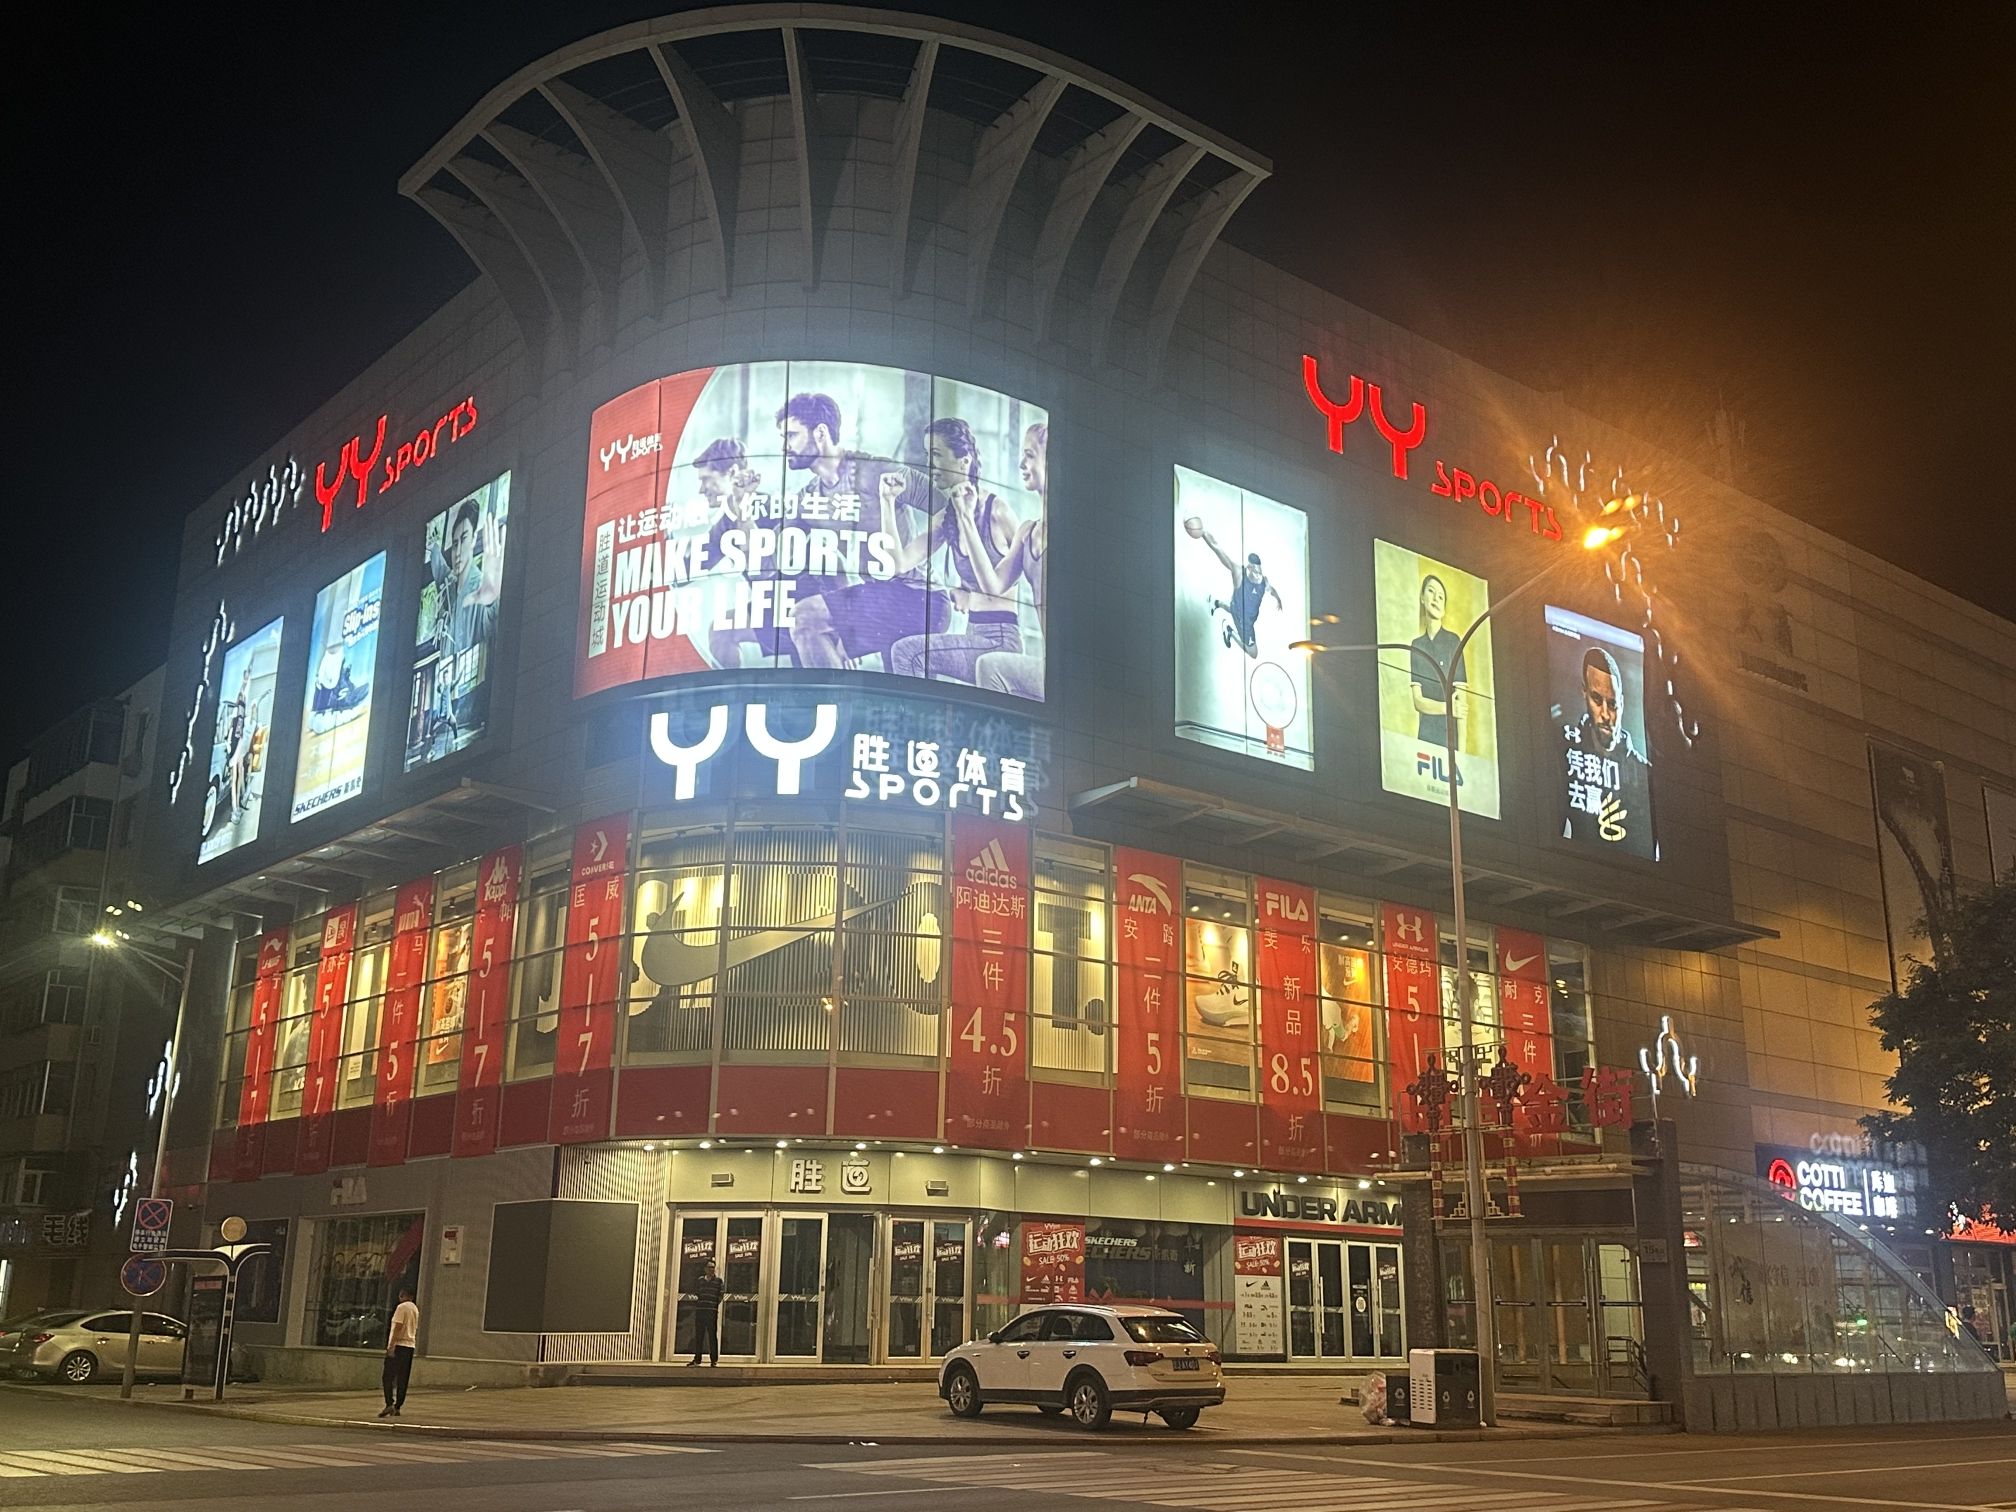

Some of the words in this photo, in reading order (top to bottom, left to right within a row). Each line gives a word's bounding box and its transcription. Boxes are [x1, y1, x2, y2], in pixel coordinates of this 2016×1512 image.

[600, 434, 633, 472] YY
[1303, 354, 1427, 480] YY
[1430, 460, 1562, 541] SPORTS
[315, 414, 388, 533] YY
[379, 396, 478, 494] SPORTS
[614, 532, 710, 599] MAKE
[720, 526, 897, 582] SPORTS
[611, 586, 704, 648] YOUR
[712, 580, 797, 632] LIFE
[650, 703, 838, 801] YY
[852, 733, 1027, 797] 胜道体育
[1566, 748, 1621, 791] 凭我们
[294, 785, 342, 816] SKECHERS
[845, 770, 1025, 822] SPORTS
[1568, 782, 1605, 816] 去赢
[574, 876, 620, 908] 匡威
[966, 867, 1018, 889] adidas
[956, 886, 1026, 919] 阿迪达斯
[1128, 895, 1157, 916] ANTA
[1266, 892, 1309, 922] FILA
[1124, 916, 1175, 947] 安踏
[1504, 980, 1544, 1006] 耐克
[1797, 1161, 1846, 1189] COTTI
[1241, 1191, 1337, 1222] UNDER
[1800, 1187, 1864, 1216] COFFEE
[1029, 1231, 1080, 1254] 运动狂欢
[1085, 1236, 1138, 1247] SKECHERS
